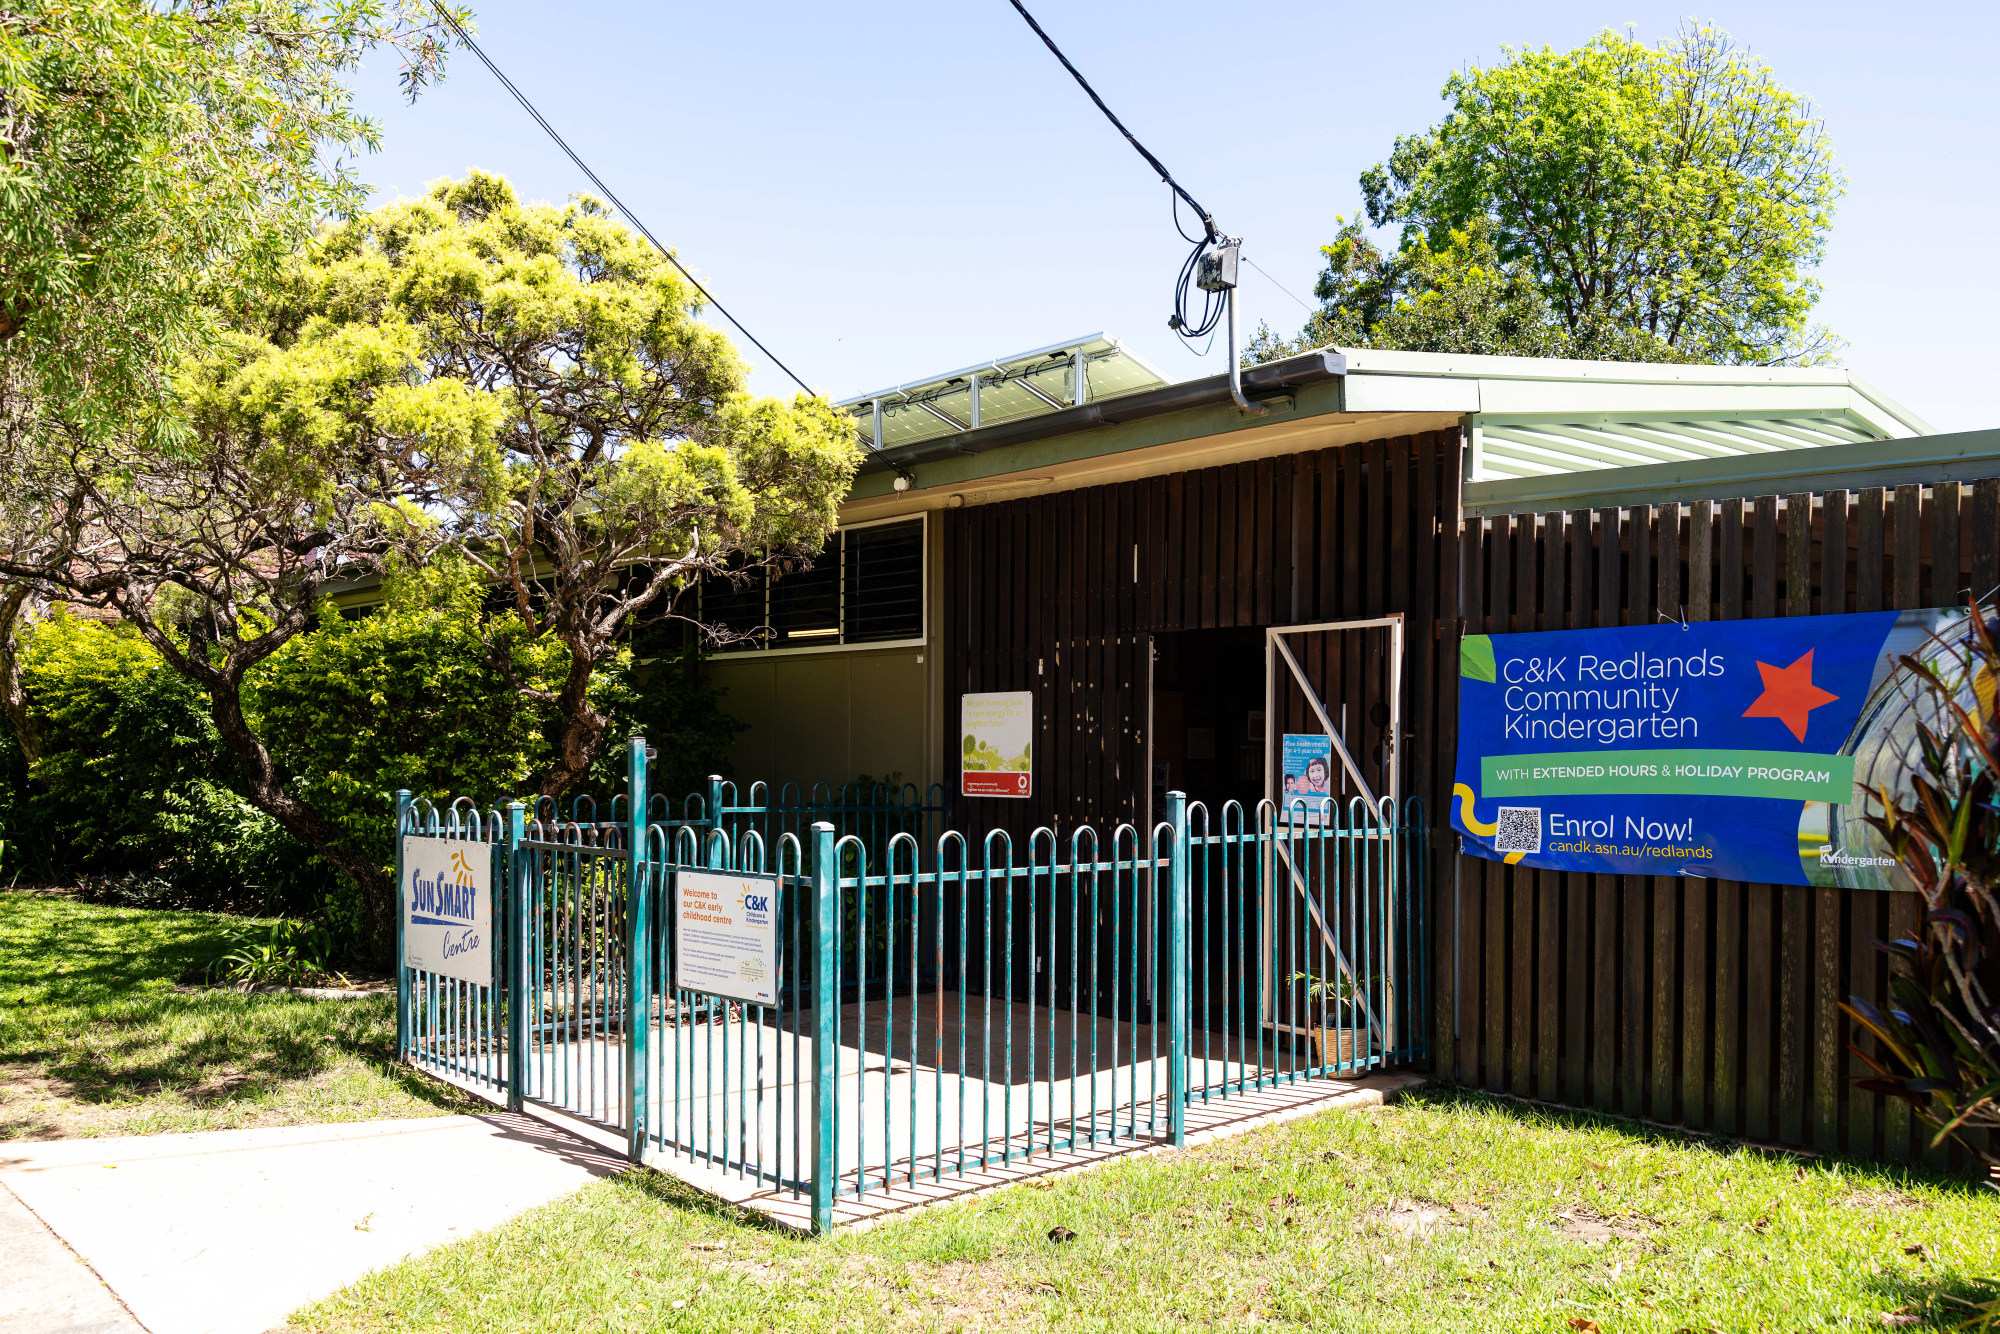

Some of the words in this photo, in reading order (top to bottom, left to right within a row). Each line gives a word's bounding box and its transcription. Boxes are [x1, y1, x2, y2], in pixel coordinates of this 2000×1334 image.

[1503, 655, 1566, 684] C&K
[1578, 648, 1725, 682] Redlands
[1503, 683, 1679, 714] Community
[1504, 713, 1698, 744] Kindergarten
[1496, 768, 1530, 781] WITH
[1533, 765, 1605, 780] EXTENDED
[1608, 763, 1658, 779] HOURS
[1661, 764, 1671, 778] &
[1674, 763, 1743, 780] HOLIDAY
[1747, 767, 1830, 784] PROGRAM
[1549, 813, 1615, 839] Enrol
[1625, 816, 1693, 842] Now!
[1549, 840, 1713, 860] candk.asn.au/redlands
[683, 888, 710, 899] Welcome
[711, 891, 718, 899] to
[745, 894, 768, 912] C&K
[694, 900, 707, 910] C&K
[708, 903, 723, 913] early
[683, 910, 712, 923] childhood
[713, 915, 732, 925] centre
[443, 929, 480, 960] Centre
